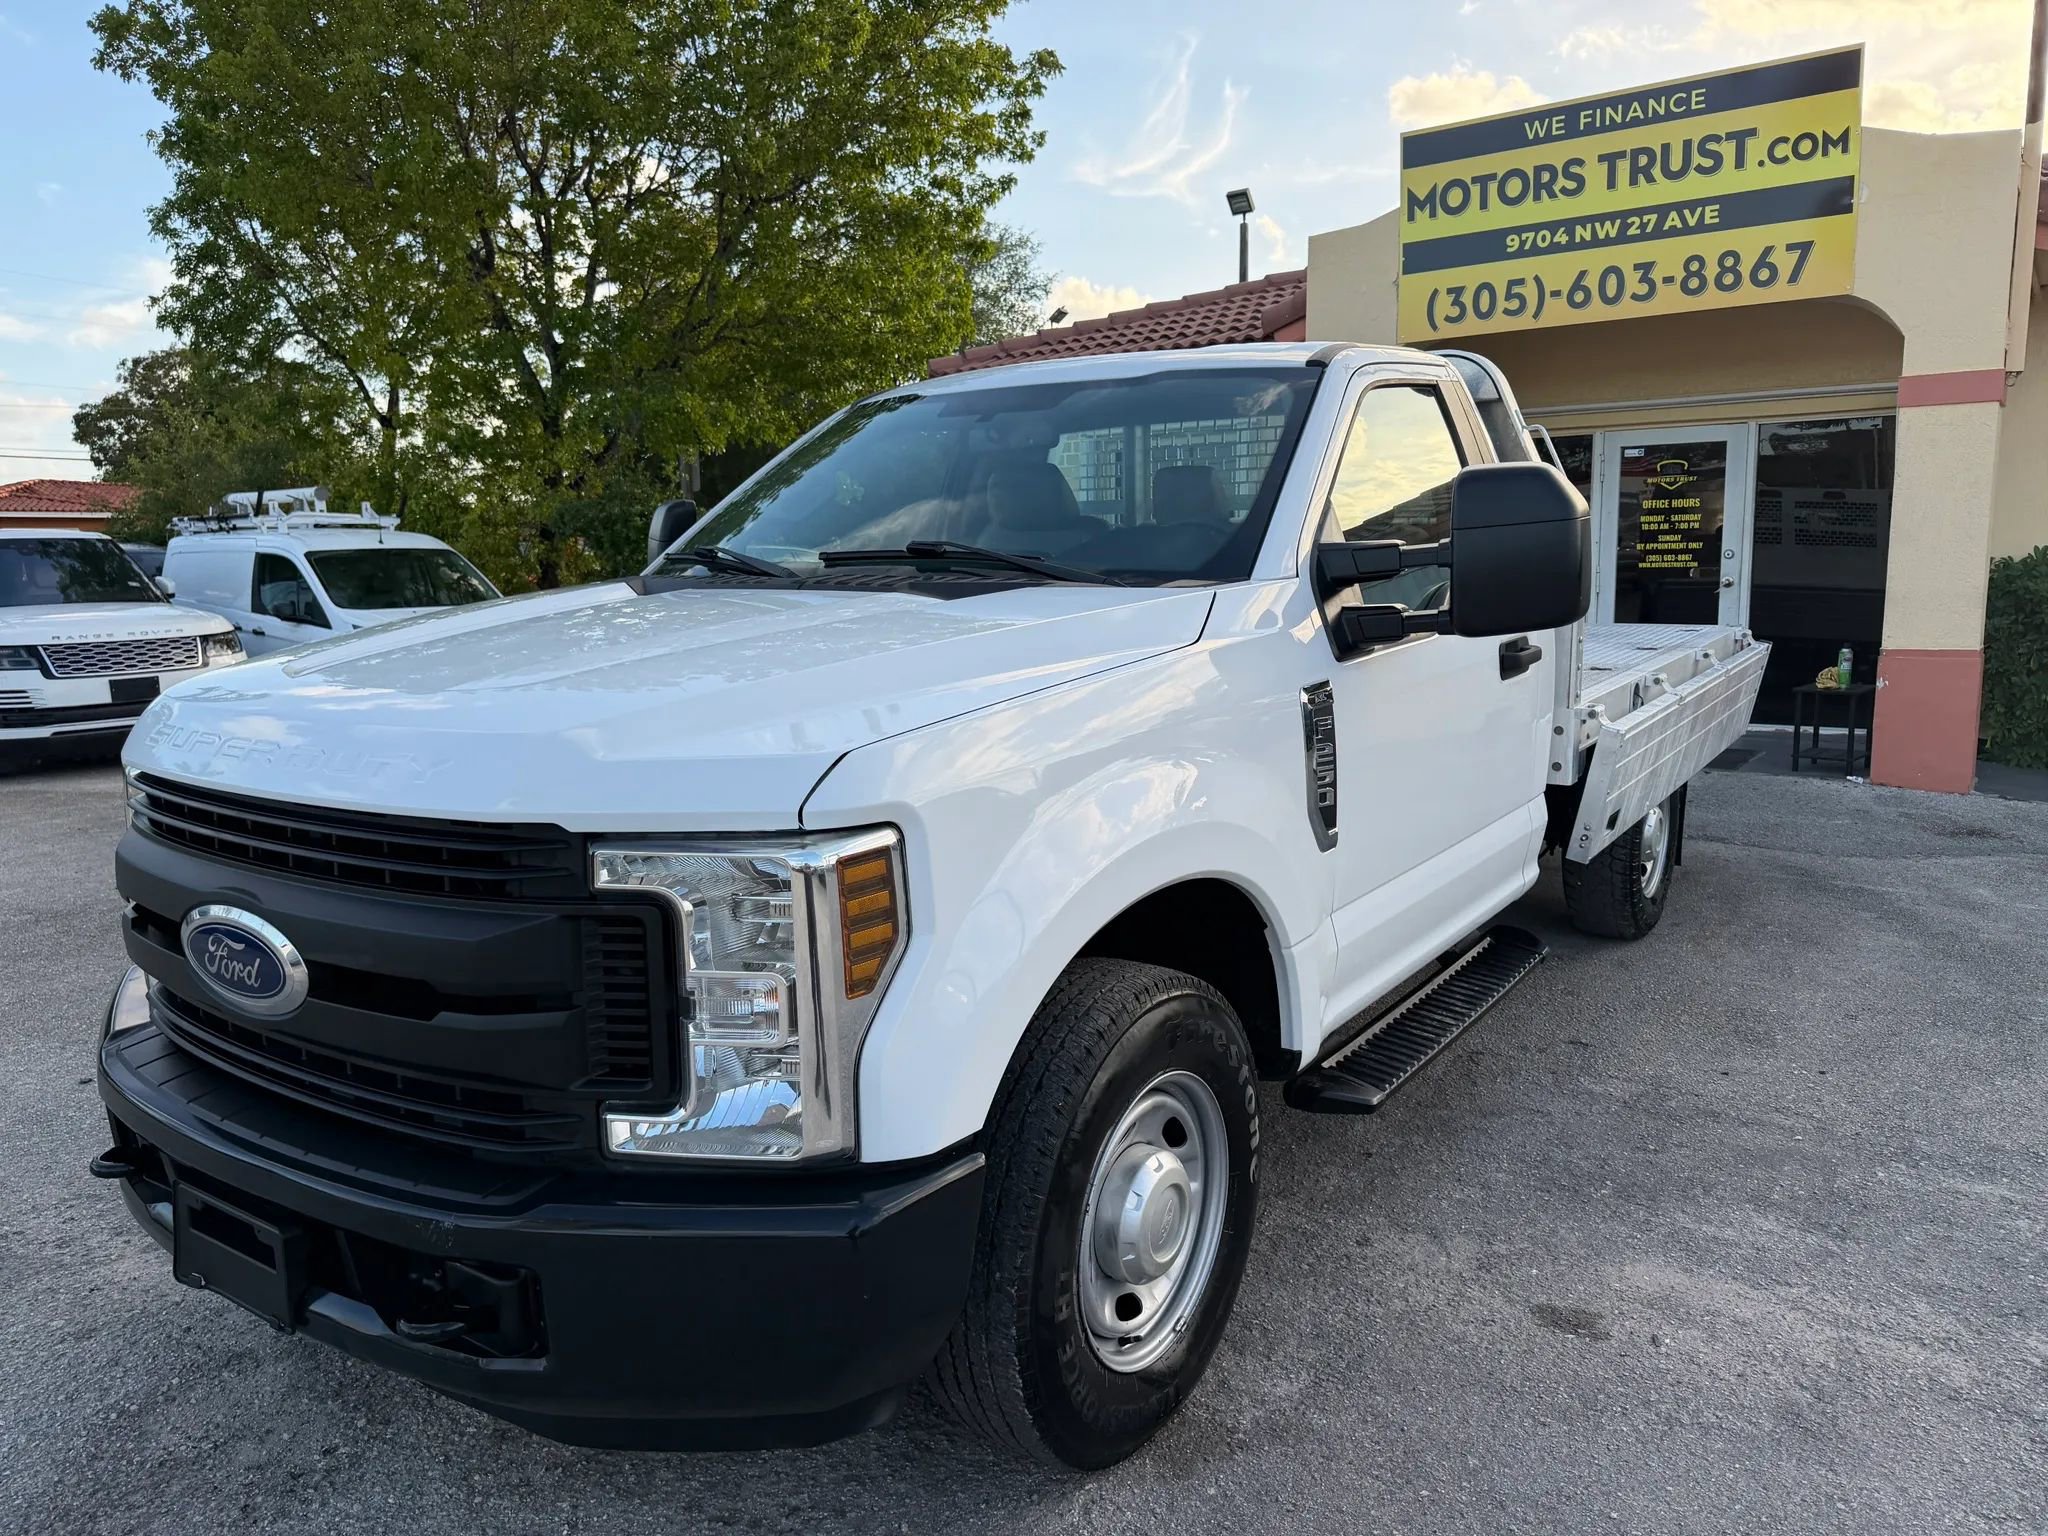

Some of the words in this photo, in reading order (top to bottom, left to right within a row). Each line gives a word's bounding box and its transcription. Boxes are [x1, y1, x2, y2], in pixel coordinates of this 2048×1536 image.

[1524, 115, 1566, 140] WE
[1579, 88, 1707, 131] FINANCE
[1406, 156, 1587, 224] MOTORS
[1597, 125, 1850, 192] TRUST.COM
[1505, 228, 1569, 253] 9704
[1574, 218, 1621, 243] NW
[1625, 213, 1659, 236] 27
[1663, 204, 1721, 231] AVE
[1426, 239, 1816, 334] (305)-603-8867
[1642, 499, 1670, 509] OFFICE
[1671, 498, 1701, 508] HOURS
[1670, 513, 1702, 521] SATURDAY
[1645, 542, 1687, 550] APPOINTMENT
[1688, 541, 1703, 549] ONLY
[1674, 522, 1688, 530] 7:00
[51, 632, 114, 641] RANGE
[127, 628, 184, 636] ROVER
[145, 722, 282, 765] SUPER
[204, 932, 263, 988] Ford
